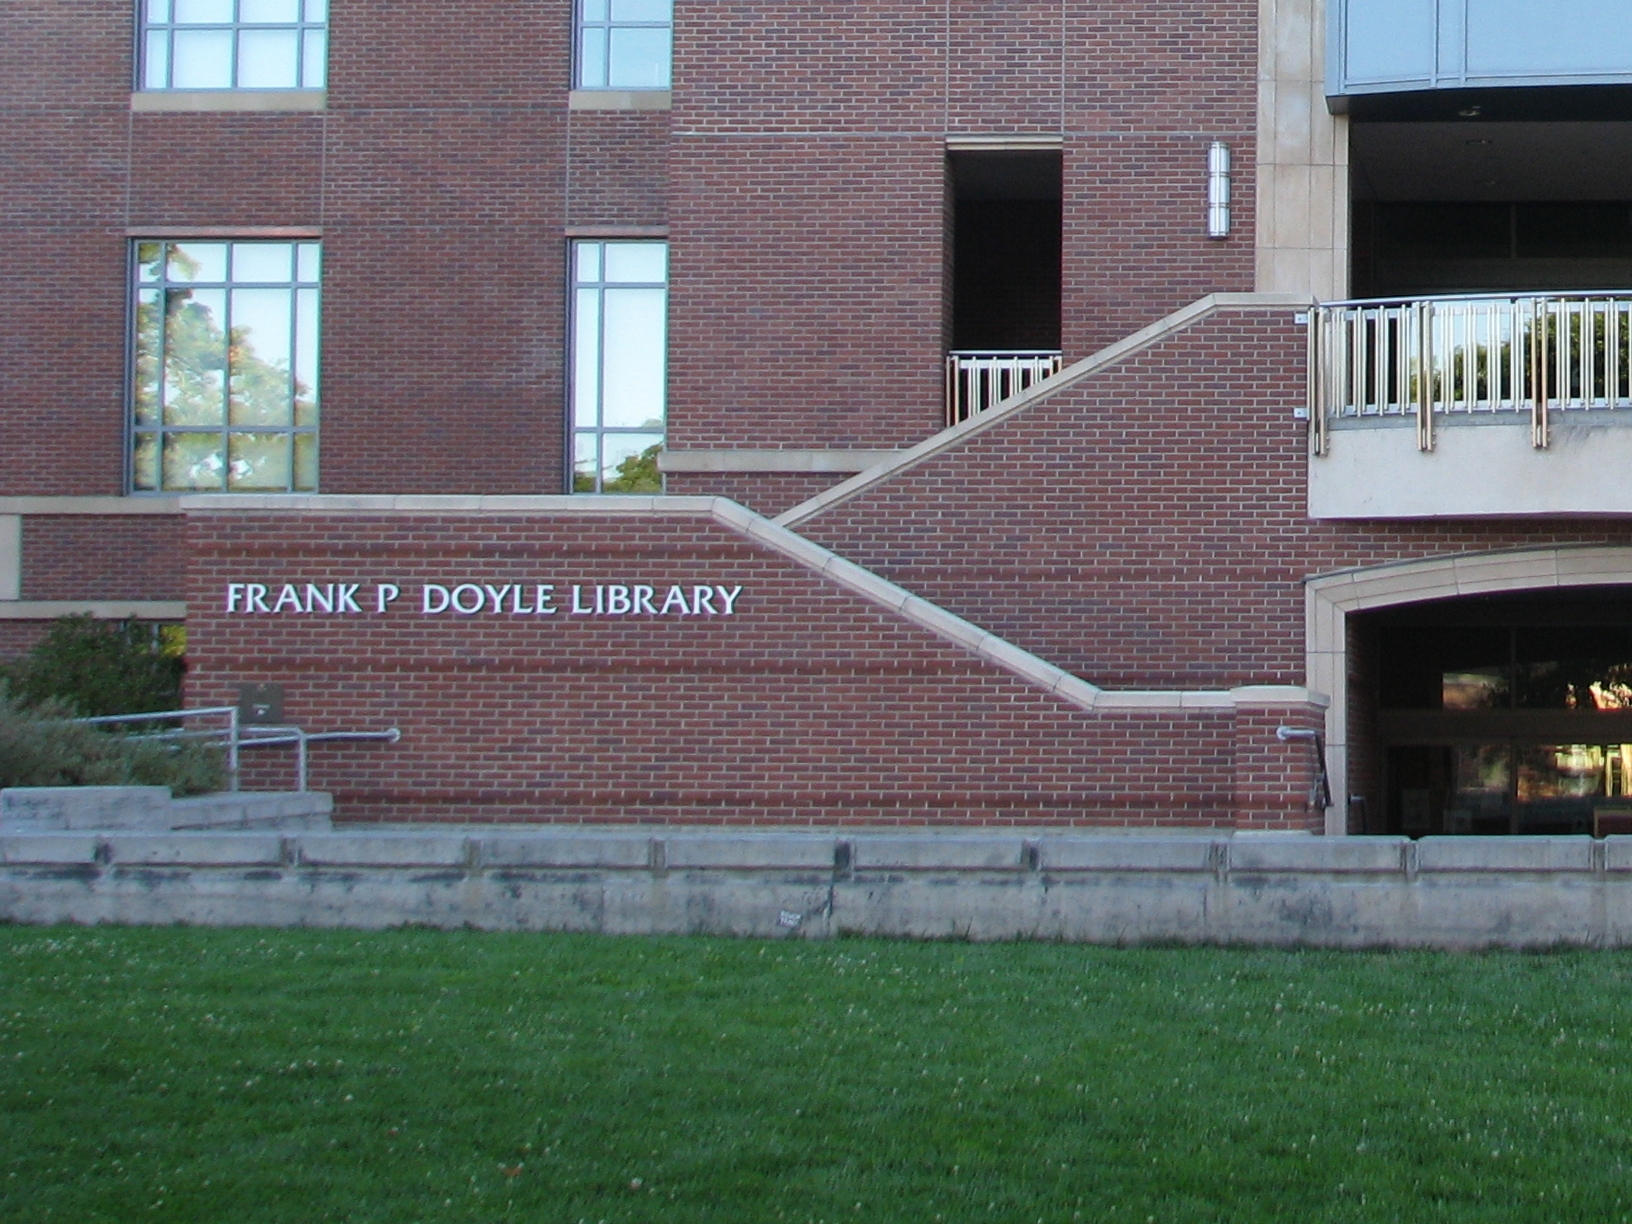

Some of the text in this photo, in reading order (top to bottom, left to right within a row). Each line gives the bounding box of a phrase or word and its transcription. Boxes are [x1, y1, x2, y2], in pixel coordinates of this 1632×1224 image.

[225, 583, 743, 615] FRANK P DOYLE LIBRARY
